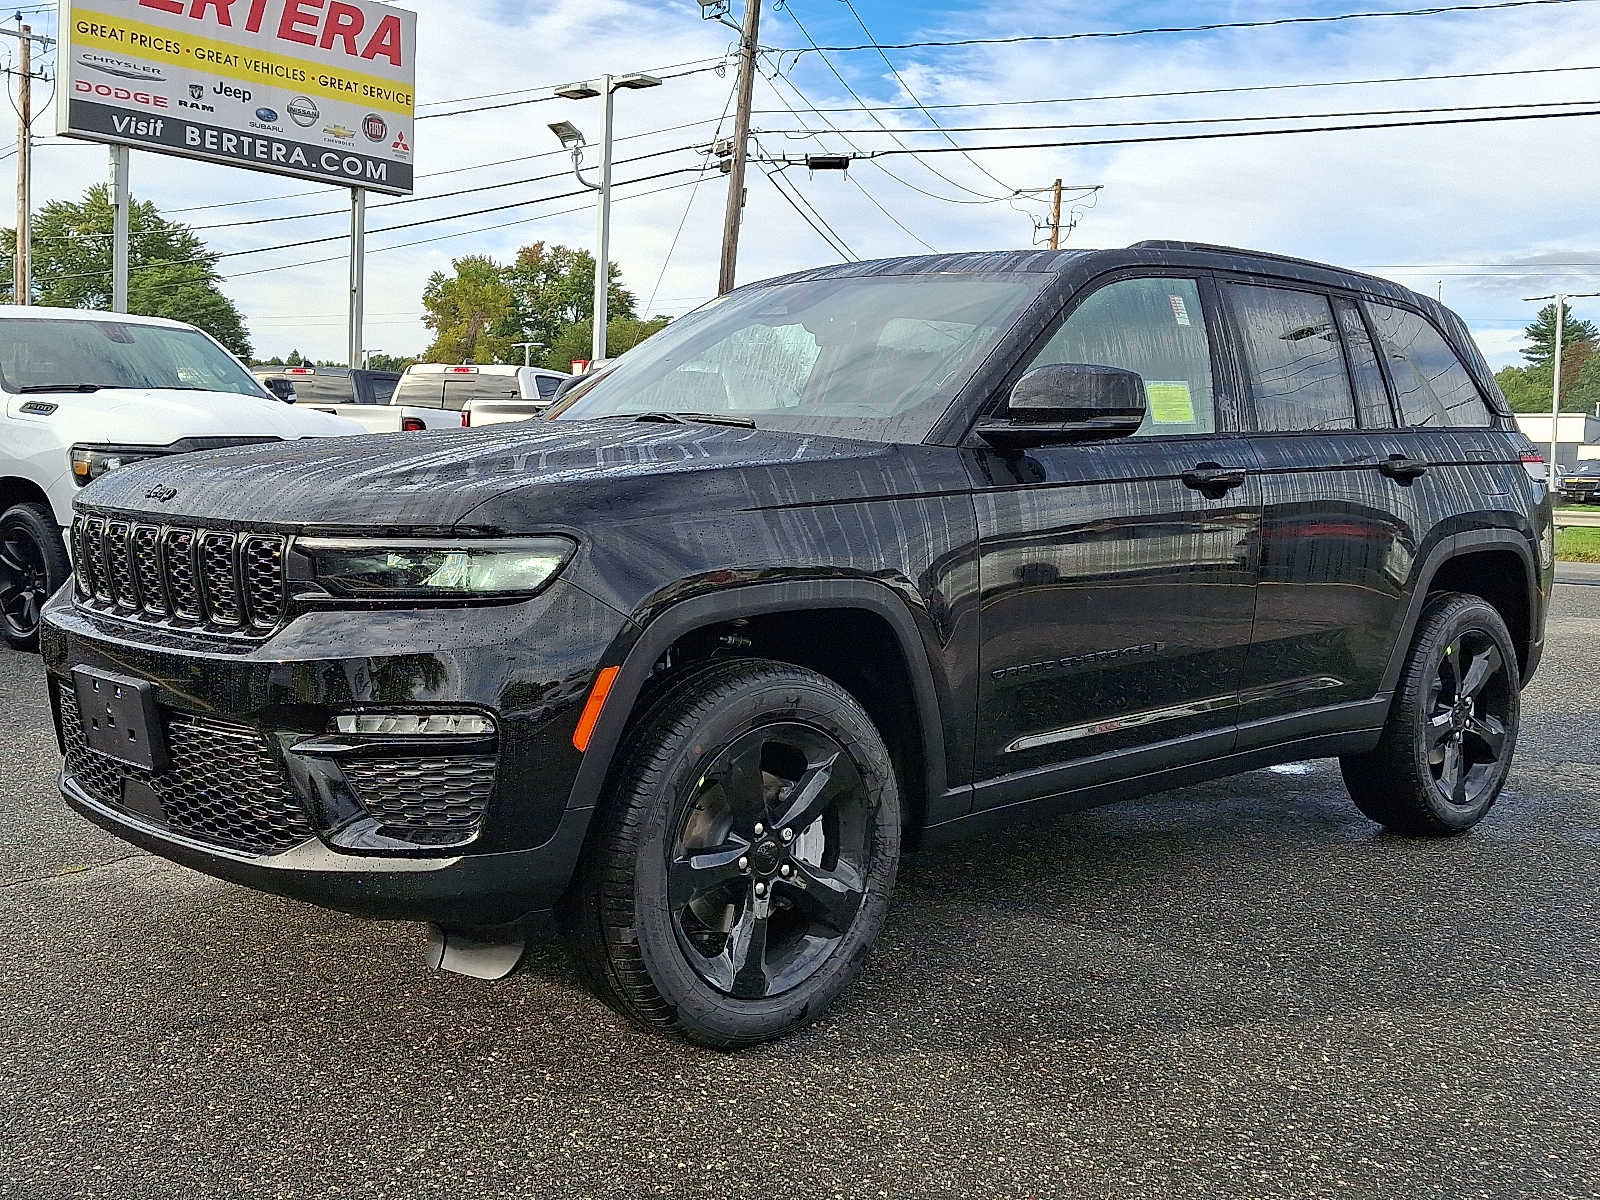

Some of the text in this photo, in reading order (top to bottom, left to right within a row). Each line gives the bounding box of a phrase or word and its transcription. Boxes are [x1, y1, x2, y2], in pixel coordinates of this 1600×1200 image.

[76, 21, 412, 106] GREAT PRICES GREAT VEHICLES GREAT SERVICE
[82, 53, 161, 75] CHRYSLER
[75, 80, 168, 109] DODGE
[212, 81, 252, 103] Jeep
[178, 99, 215, 113] RAM
[289, 106, 317, 119] NISSAN
[249, 121, 284, 133] SUBARU
[368, 121, 383, 136] FIAT
[111, 114, 387, 182] Visit BERTERA.COM
